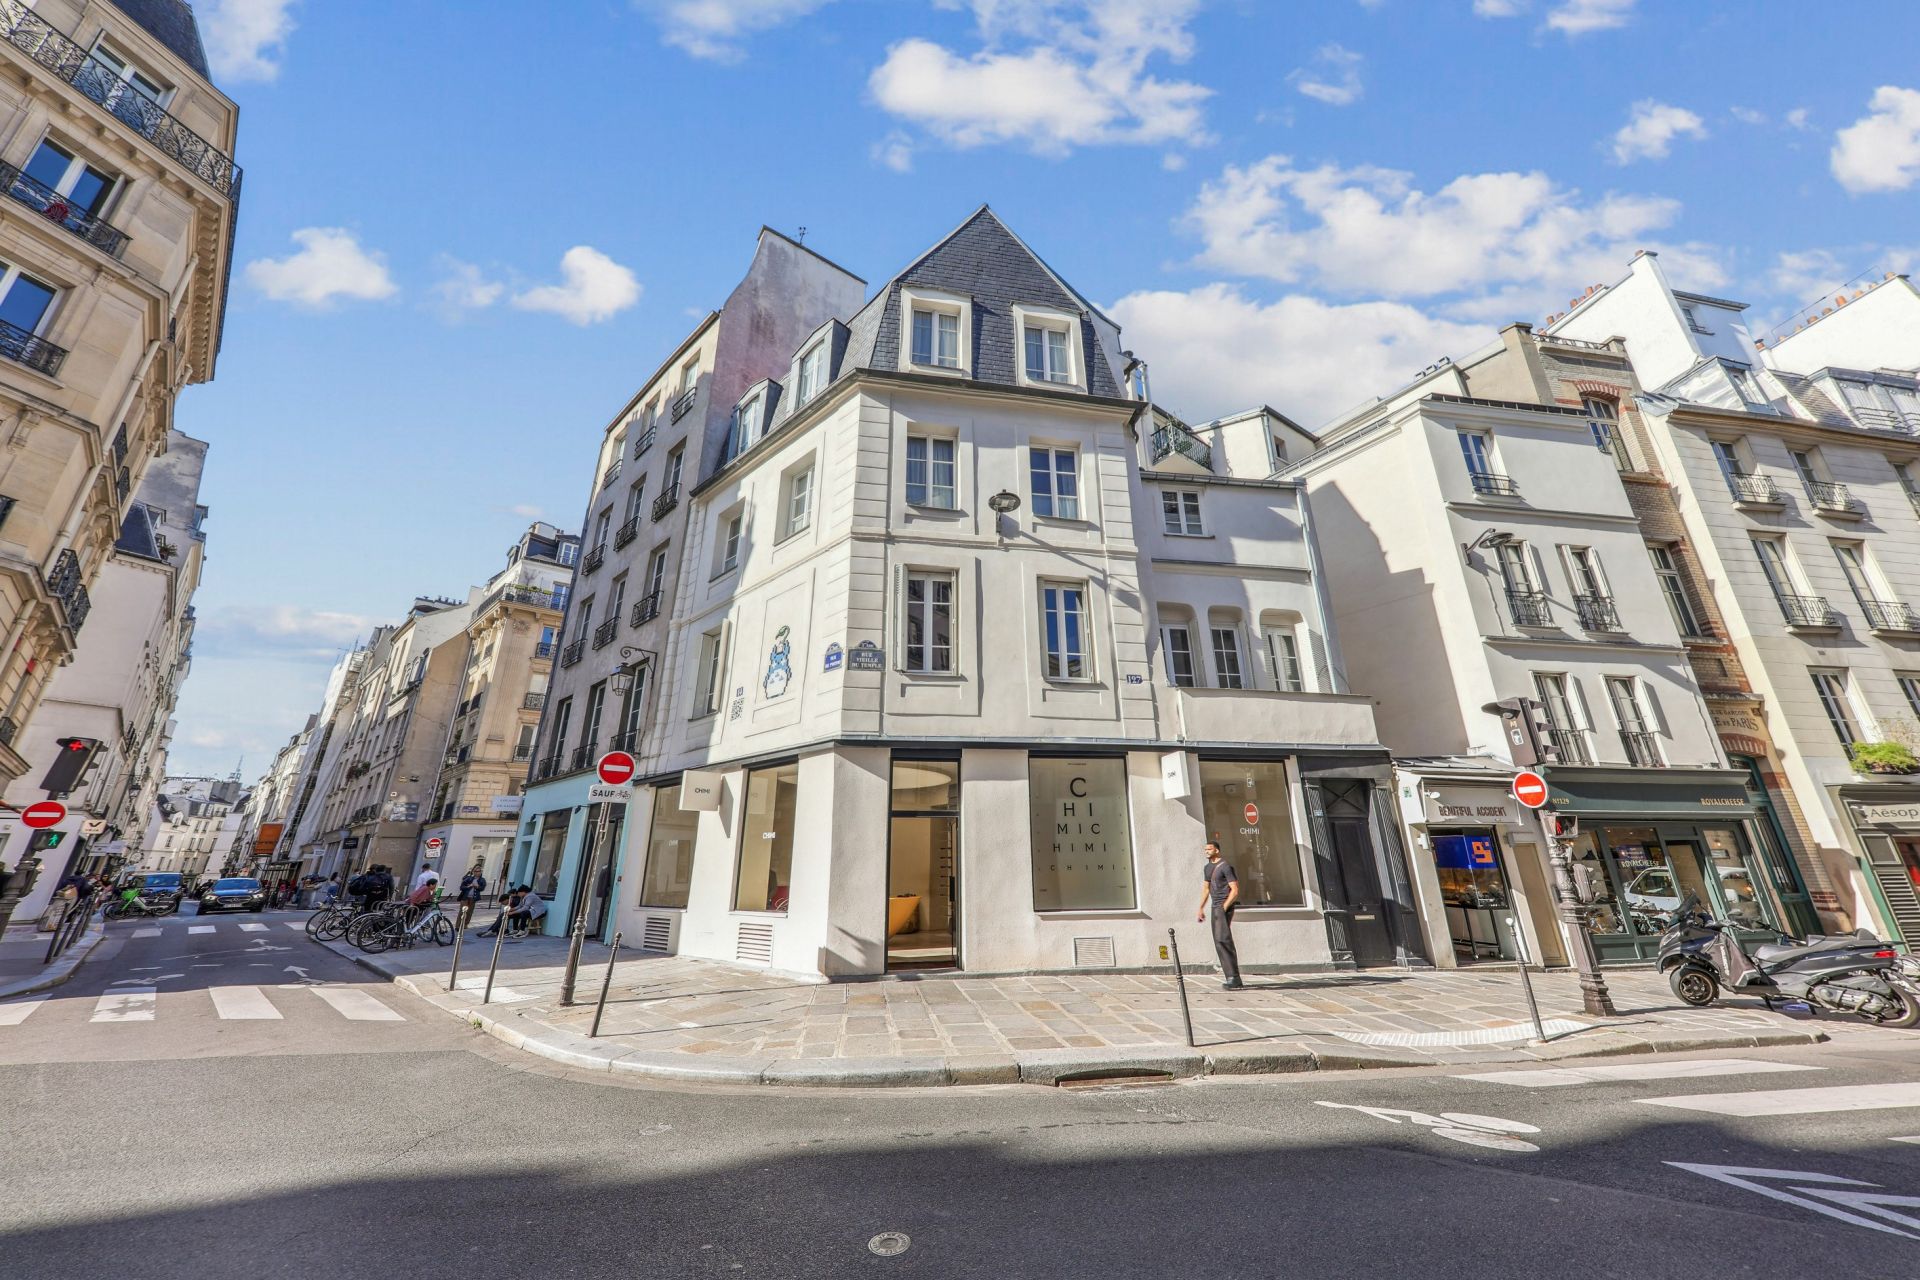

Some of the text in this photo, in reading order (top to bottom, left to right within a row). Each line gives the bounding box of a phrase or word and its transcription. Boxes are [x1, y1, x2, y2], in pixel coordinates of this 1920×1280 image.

[1128, 675, 1140, 684] 127
[1730, 717, 1760, 732] PARIS
[1069, 777, 1087, 798] C
[592, 789, 616, 798] SAUF
[1700, 798, 1745, 806] ROYALCHEESE
[1438, 805, 1508, 817] BEAUTIFUL ACCIDENT
[1239, 827, 1260, 835] CHIMI
